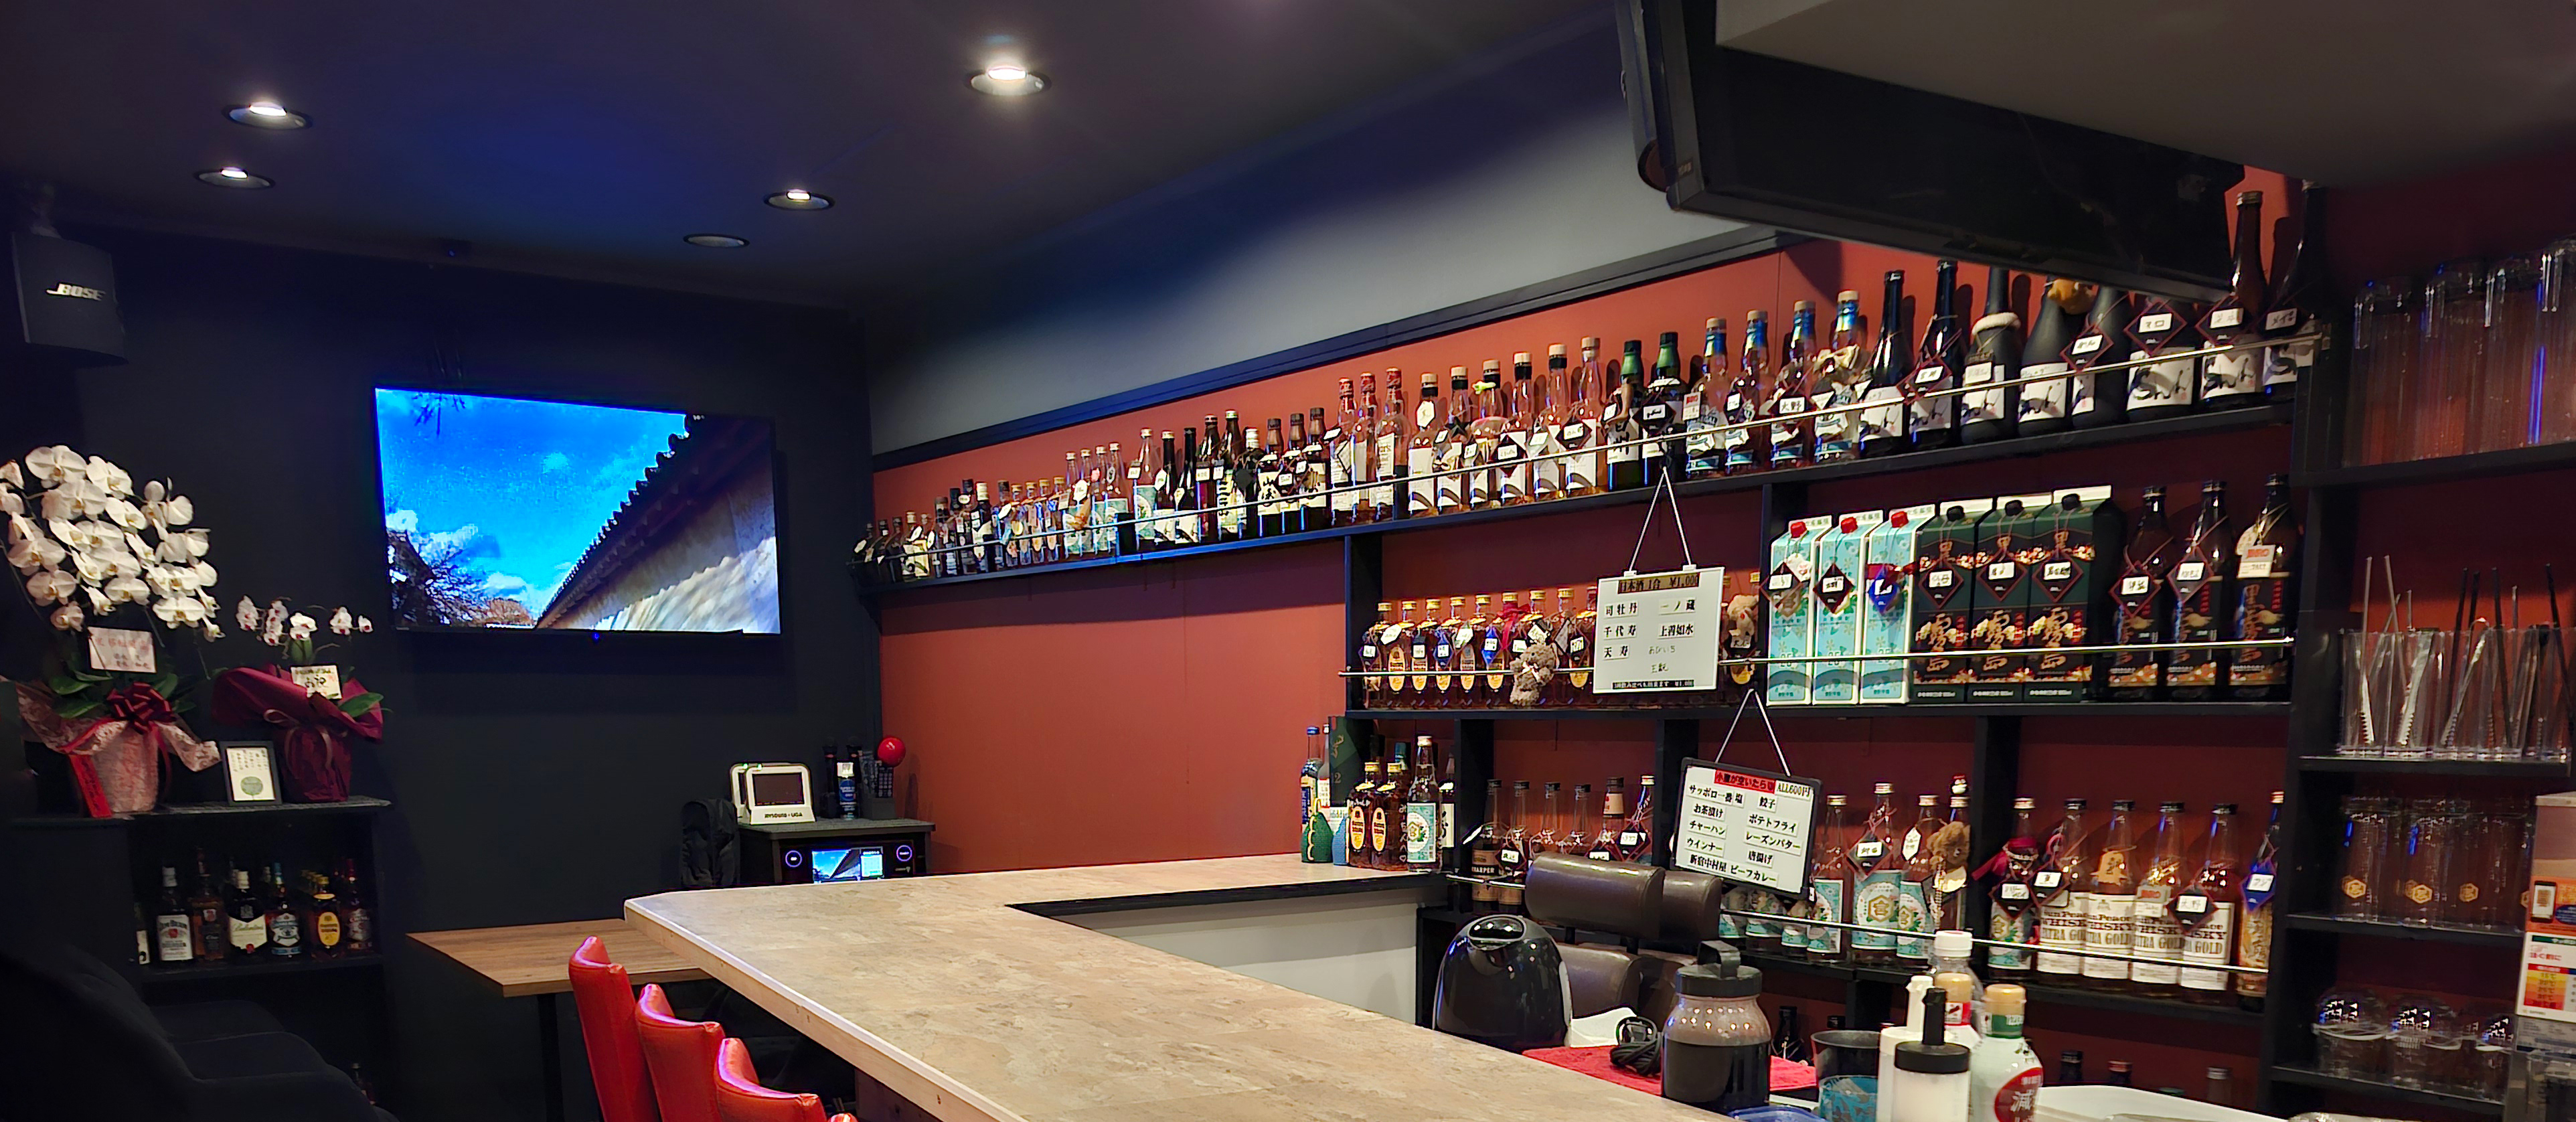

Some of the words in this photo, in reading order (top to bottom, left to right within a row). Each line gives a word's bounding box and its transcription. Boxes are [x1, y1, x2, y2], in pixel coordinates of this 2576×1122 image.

[46, 283, 106, 301] BOSE
[2247, 549, 2271, 560] JINRO
[1606, 602, 1637, 617] 司牡丹
[1660, 599, 1695, 611] 一ノ蔵
[1604, 625, 1636, 638] 千代寿
[1661, 623, 1694, 637] 上善如水
[1604, 645, 1628, 658] 天寿
[1689, 784, 1733, 803] サッポロ一番
[1759, 796, 1775, 809] 餃子
[1693, 803, 1724, 818] お茶漬け
[1689, 819, 1726, 835] チャーハン
[1749, 813, 1797, 833] ポテトフライ
[1687, 837, 1723, 852] ウインナー
[1746, 831, 1801, 850] レーズンバター
[1748, 850, 1773, 865] 唐揚げ
[1690, 854, 1727, 872] 新宿中村屋
[1730, 864, 1777, 882] ビーフカレー
[2195, 941, 2223, 954] GOLD
